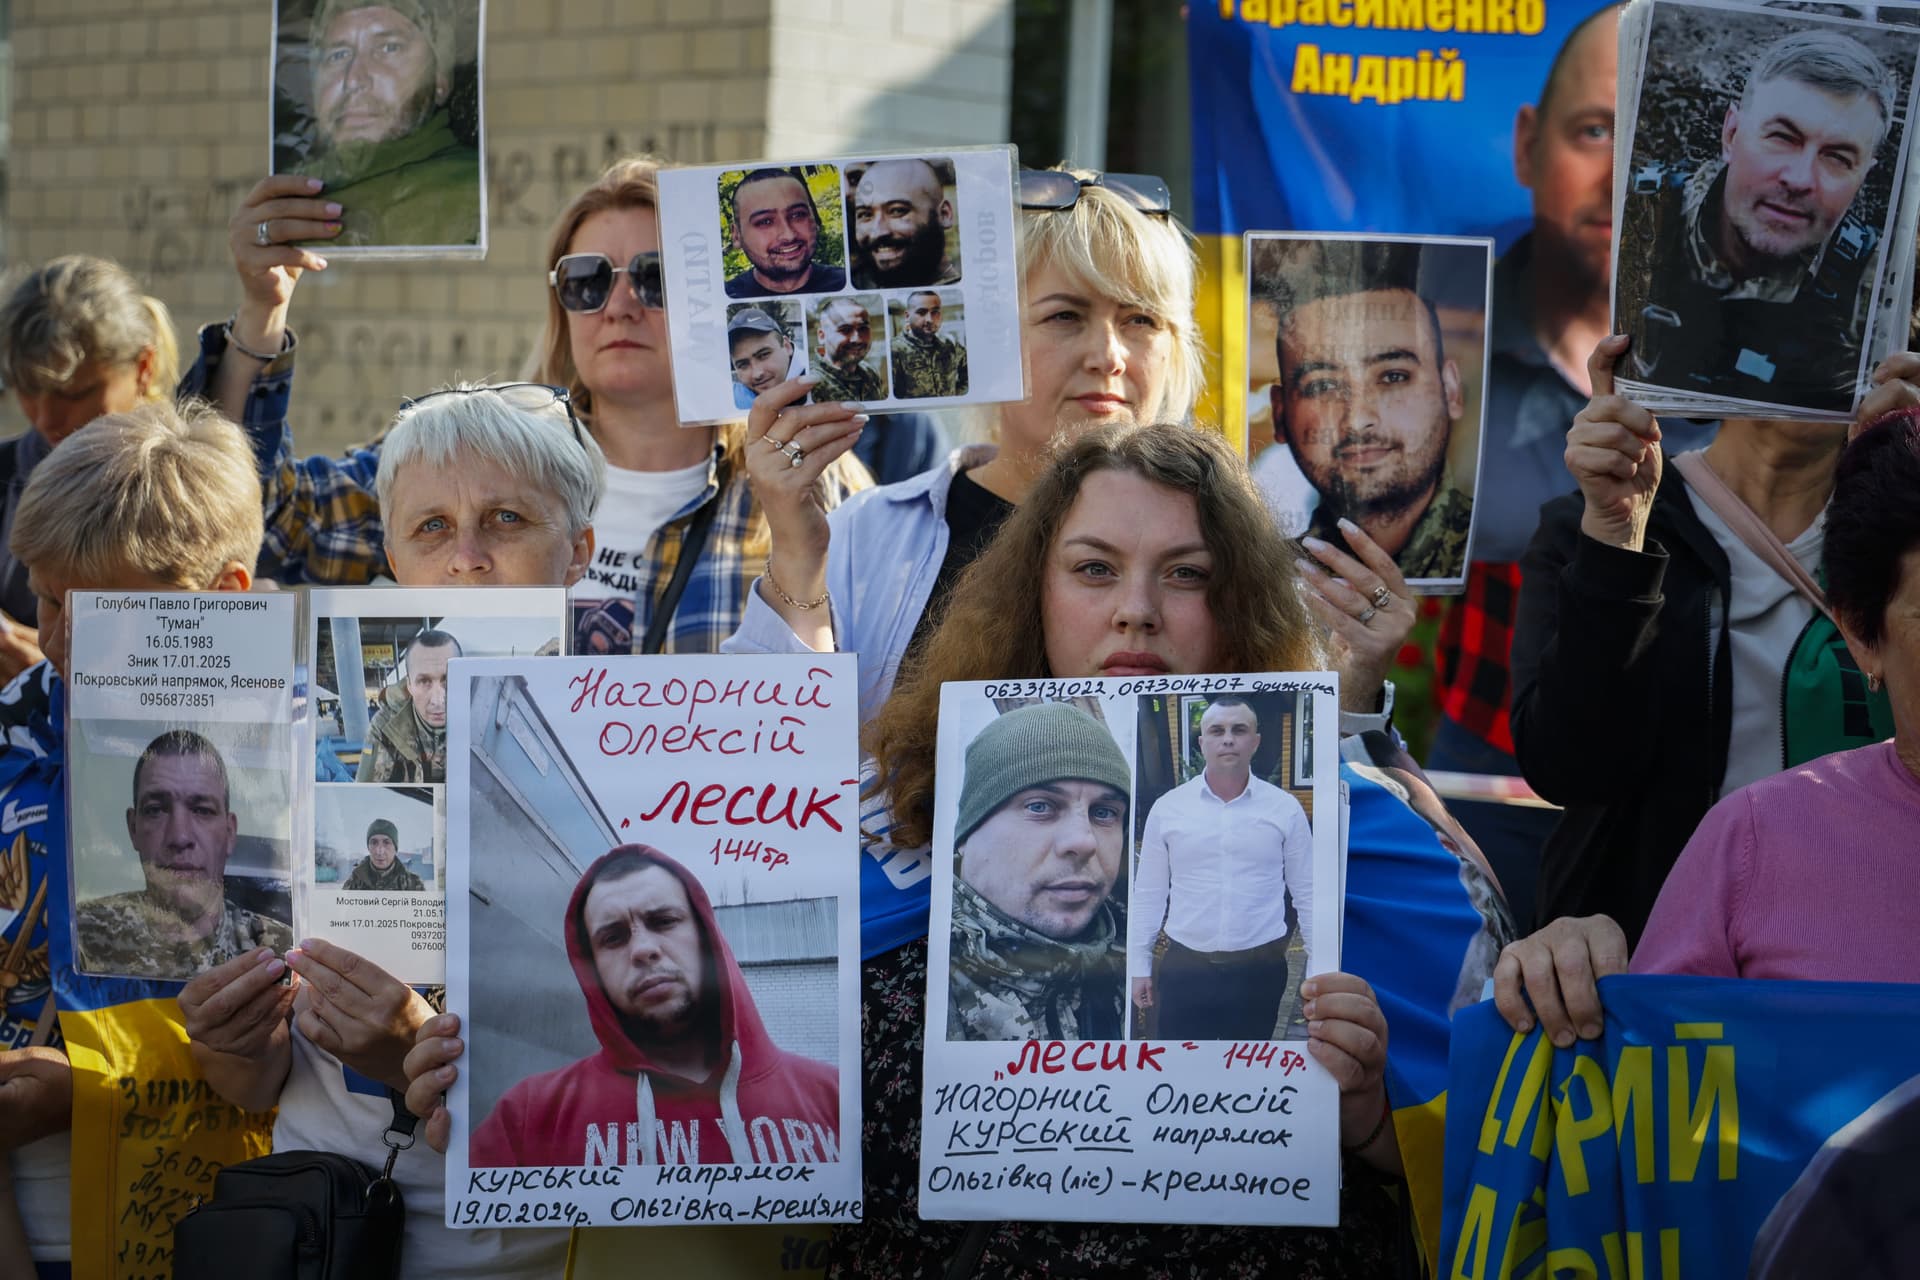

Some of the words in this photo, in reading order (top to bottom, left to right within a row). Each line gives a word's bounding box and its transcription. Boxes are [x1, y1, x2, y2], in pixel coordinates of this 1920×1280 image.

[1291, 43, 1466, 105] Андрій
[95, 597, 146, 613] Голубич
[150, 597, 190, 610] Павло
[193, 597, 268, 613] Григорович
[156, 616, 205, 632] "Туман"
[145, 635, 214, 649] 16.05.1983
[127, 654, 159, 668] Зник
[163, 655, 231, 669] 17.01.2025
[74, 672, 158, 689] Покровський
[161, 675, 228, 690] напрямок,
[231, 675, 286, 689] Ясенове
[140, 693, 215, 707] 0956873851
[569, 667, 833, 724] Нагорний
[599, 716, 806, 756] Олексій
[336, 897, 380, 906] Мостовий
[381, 897, 409, 907] Сергій
[411, 898, 447, 908] Володи
[413, 909, 447, 918] 21.05.1
[329, 920, 350, 928] зник
[353, 919, 398, 928] 17.01.2025
[934, 1083, 1113, 1124] Нагорний
[1146, 1083, 1299, 1115] Олексій
[1153, 1126, 1293, 1154] напрямок
[656, 1164, 816, 1196] напрямок
